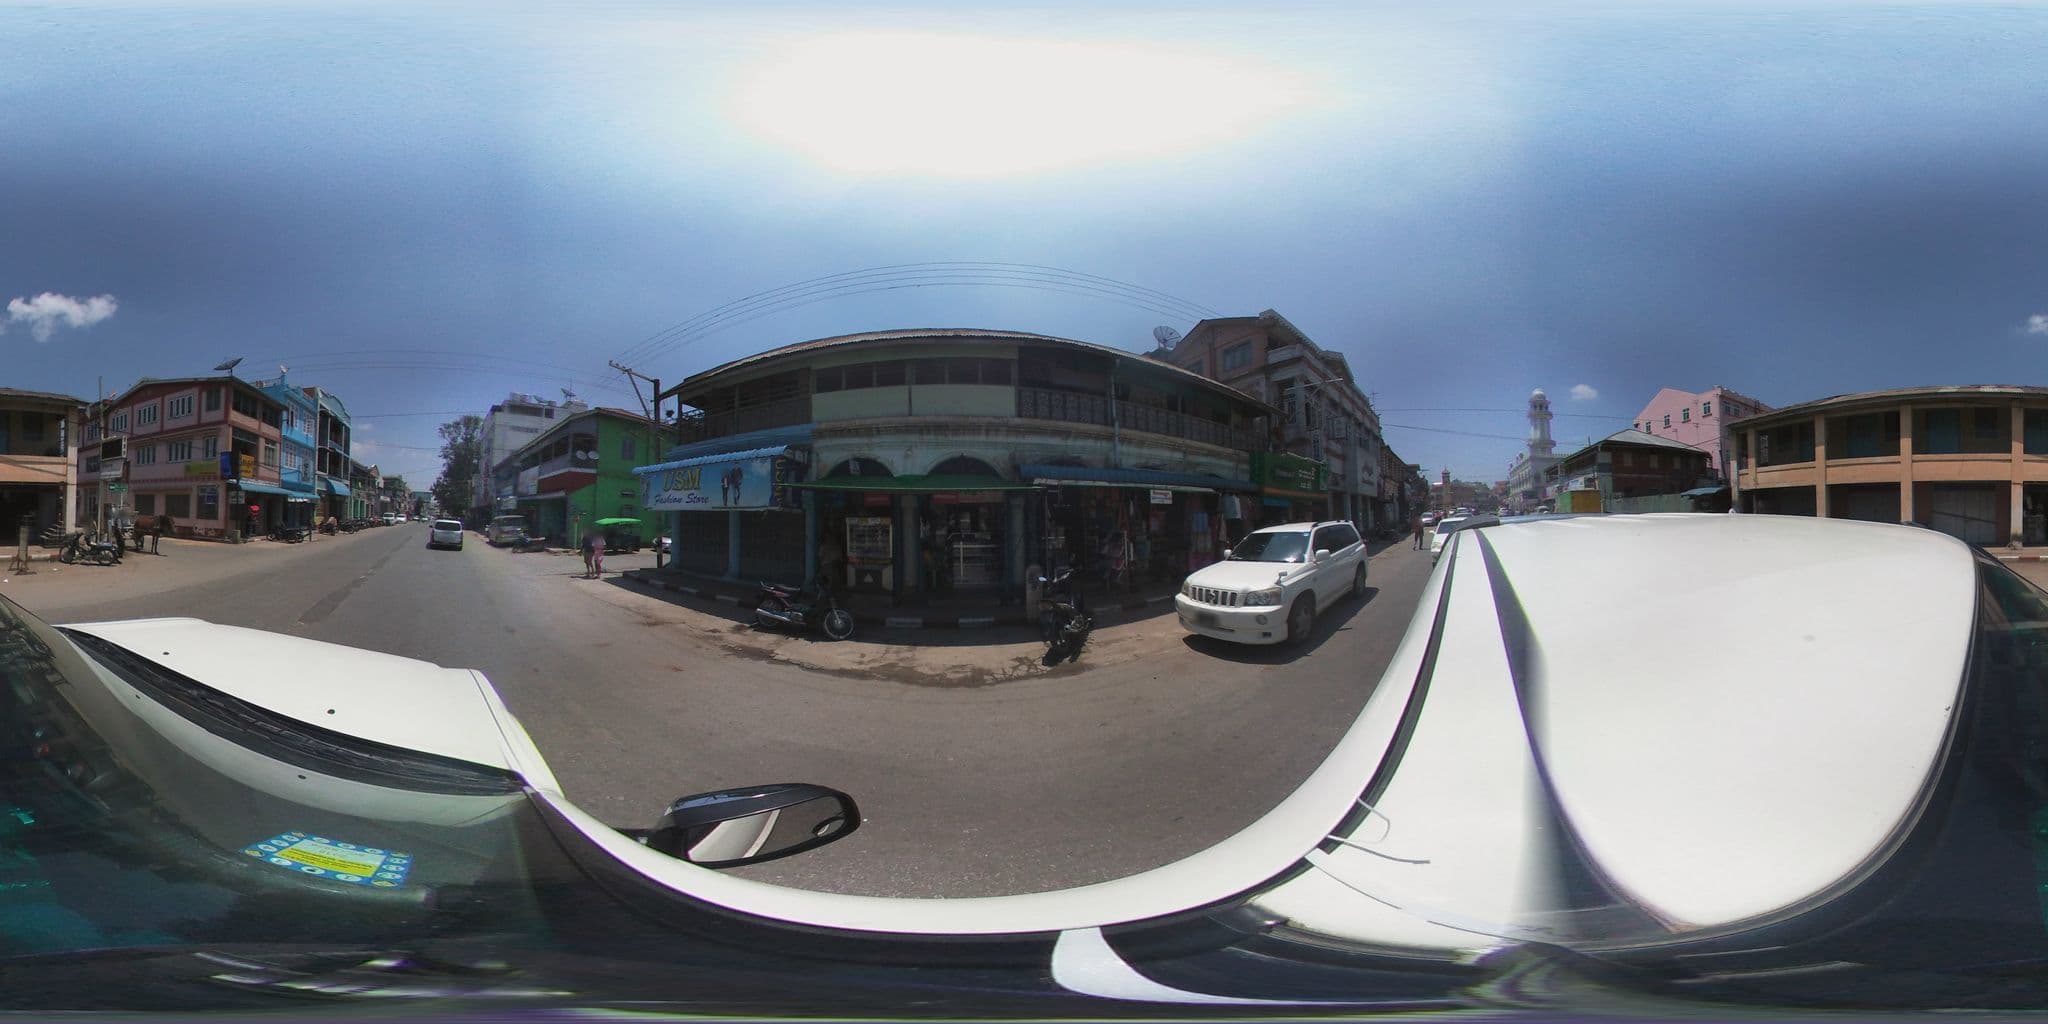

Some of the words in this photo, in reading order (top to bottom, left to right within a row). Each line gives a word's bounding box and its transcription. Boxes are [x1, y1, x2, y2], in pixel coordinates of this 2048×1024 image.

[662, 467, 703, 492] USM
[654, 493, 683, 505] Fashion
[685, 492, 710, 504] Store
